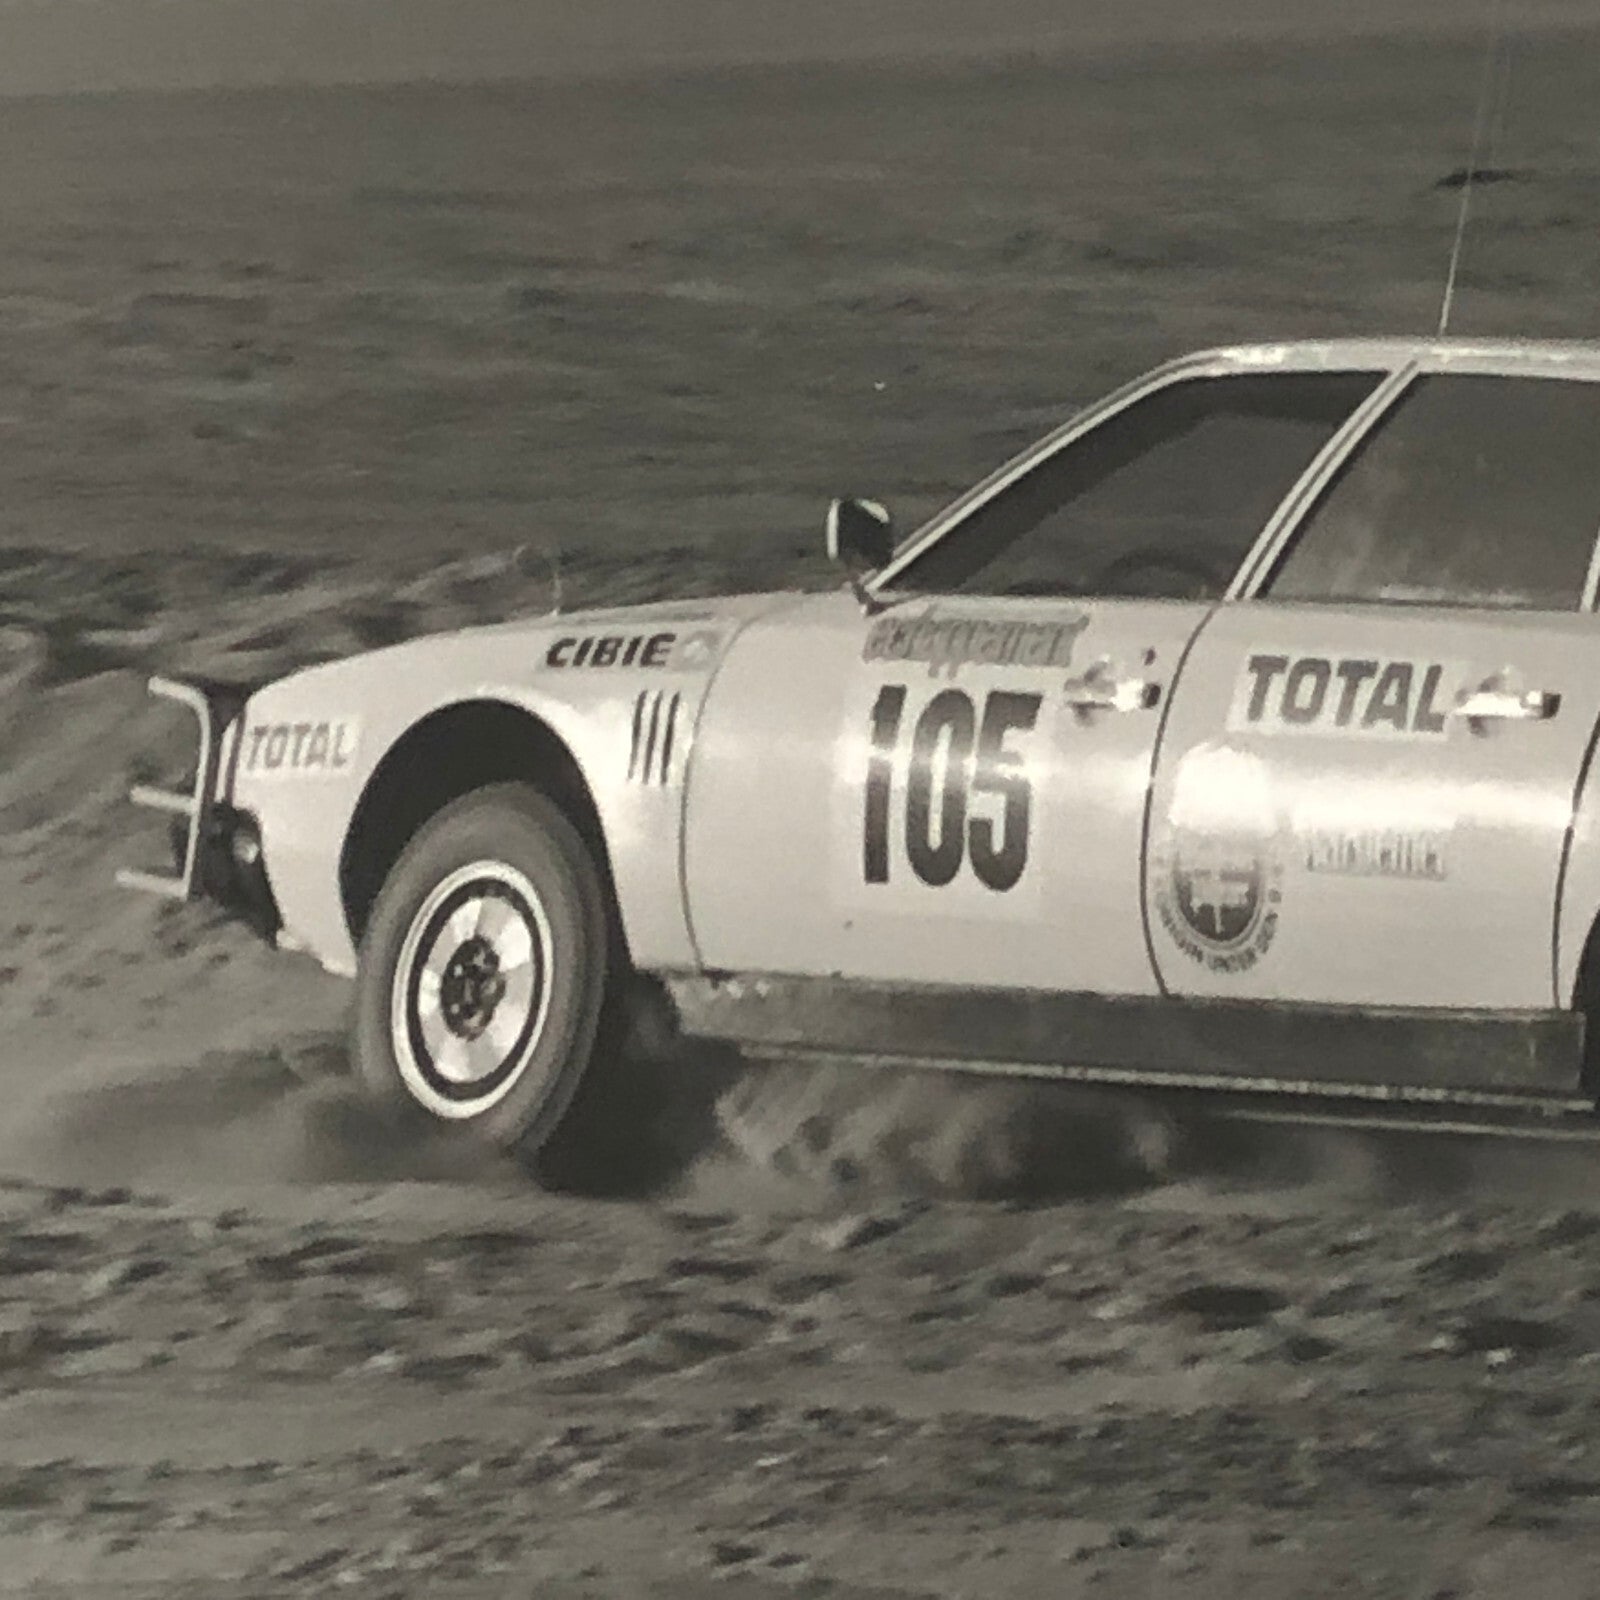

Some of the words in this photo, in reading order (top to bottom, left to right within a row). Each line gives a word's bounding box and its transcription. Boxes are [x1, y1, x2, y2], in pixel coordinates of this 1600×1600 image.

[546, 633, 676, 667] CIBIE
[1247, 655, 1444, 732] TOTAL
[247, 723, 346, 770] TOTAL
[864, 684, 1042, 892] 105
